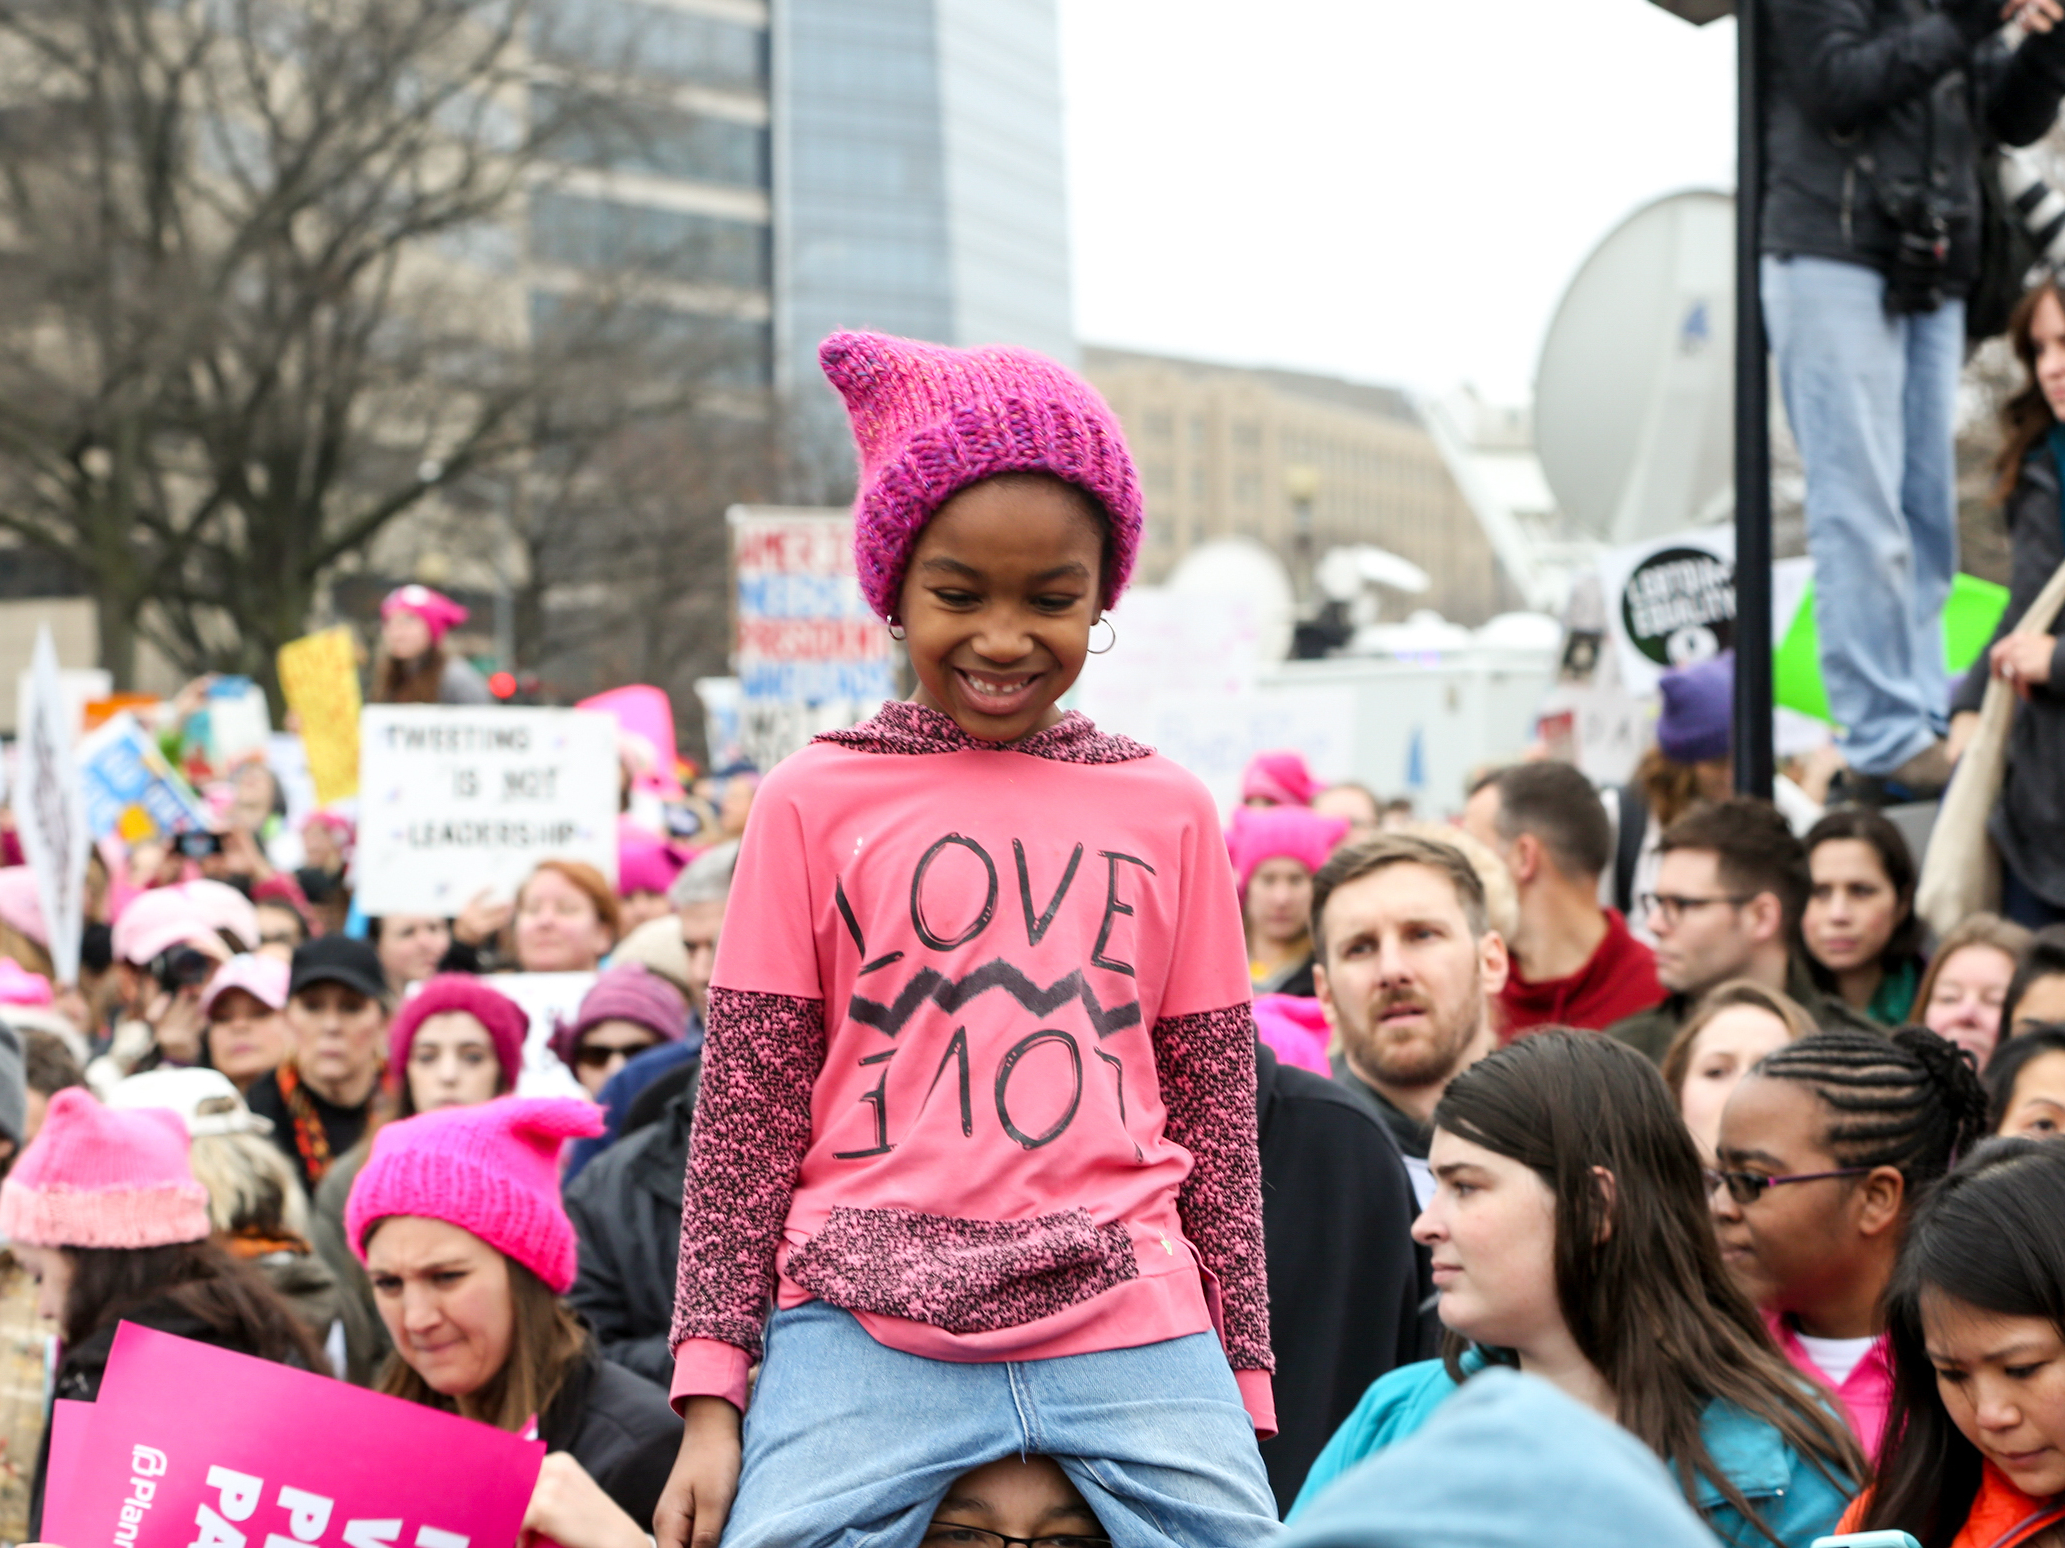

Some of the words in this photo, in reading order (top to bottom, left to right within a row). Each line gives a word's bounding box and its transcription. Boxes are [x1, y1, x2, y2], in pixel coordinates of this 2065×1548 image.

[386, 724, 531, 751] TWEETING
[453, 769, 481, 799] IS
[502, 767, 557, 802] NOT
[409, 819, 575, 849] LEADERSHIP
[836, 832, 1157, 978] LOVE
